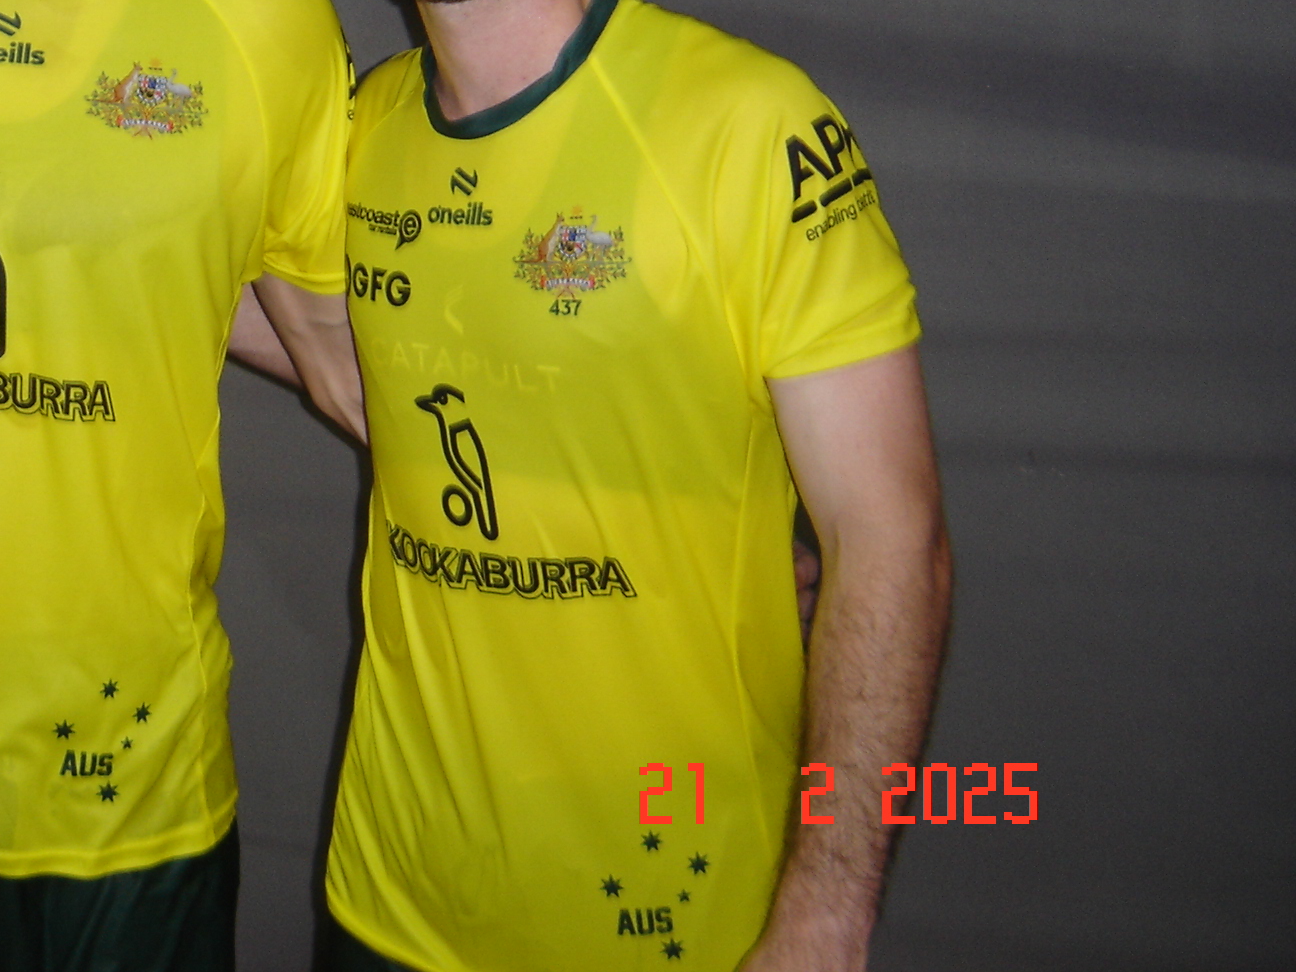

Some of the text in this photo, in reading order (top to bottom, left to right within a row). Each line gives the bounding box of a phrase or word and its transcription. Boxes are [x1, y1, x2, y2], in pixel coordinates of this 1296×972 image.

[805, 203, 859, 241] enabling
[352, 262, 412, 307] GFG
[549, 299, 582, 316] 437
[59, 749, 114, 777] AUS
[617, 906, 674, 935] AUS
